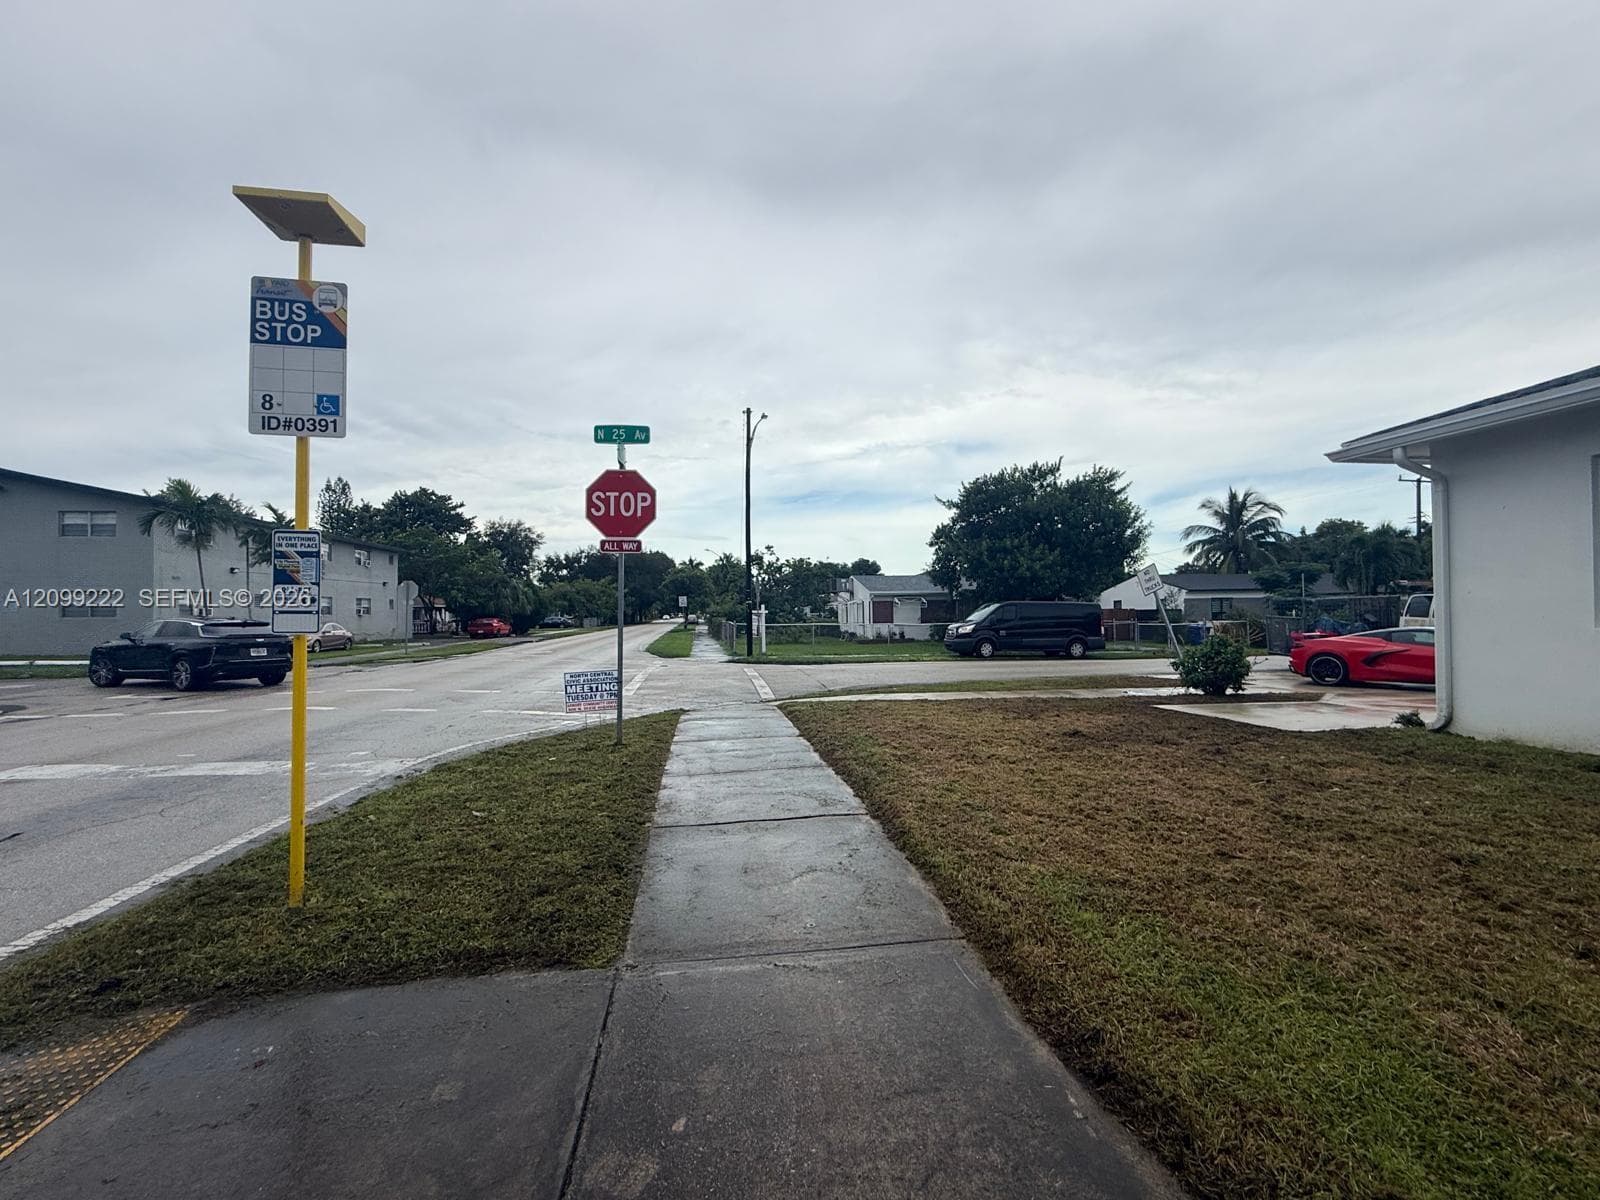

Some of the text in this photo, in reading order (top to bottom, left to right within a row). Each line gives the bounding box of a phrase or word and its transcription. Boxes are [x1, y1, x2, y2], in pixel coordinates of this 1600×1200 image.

[255, 299, 307, 322] BUS
[254, 321, 322, 344] STOP
[261, 415, 338, 432] ID#0391
[598, 429, 604, 440] N
[612, 428, 626, 440] 25
[590, 491, 652, 517] STOP
[604, 542, 638, 550] ALL WAY
[566, 682, 618, 694] MEETING
[566, 694, 598, 702] TUESDAY
